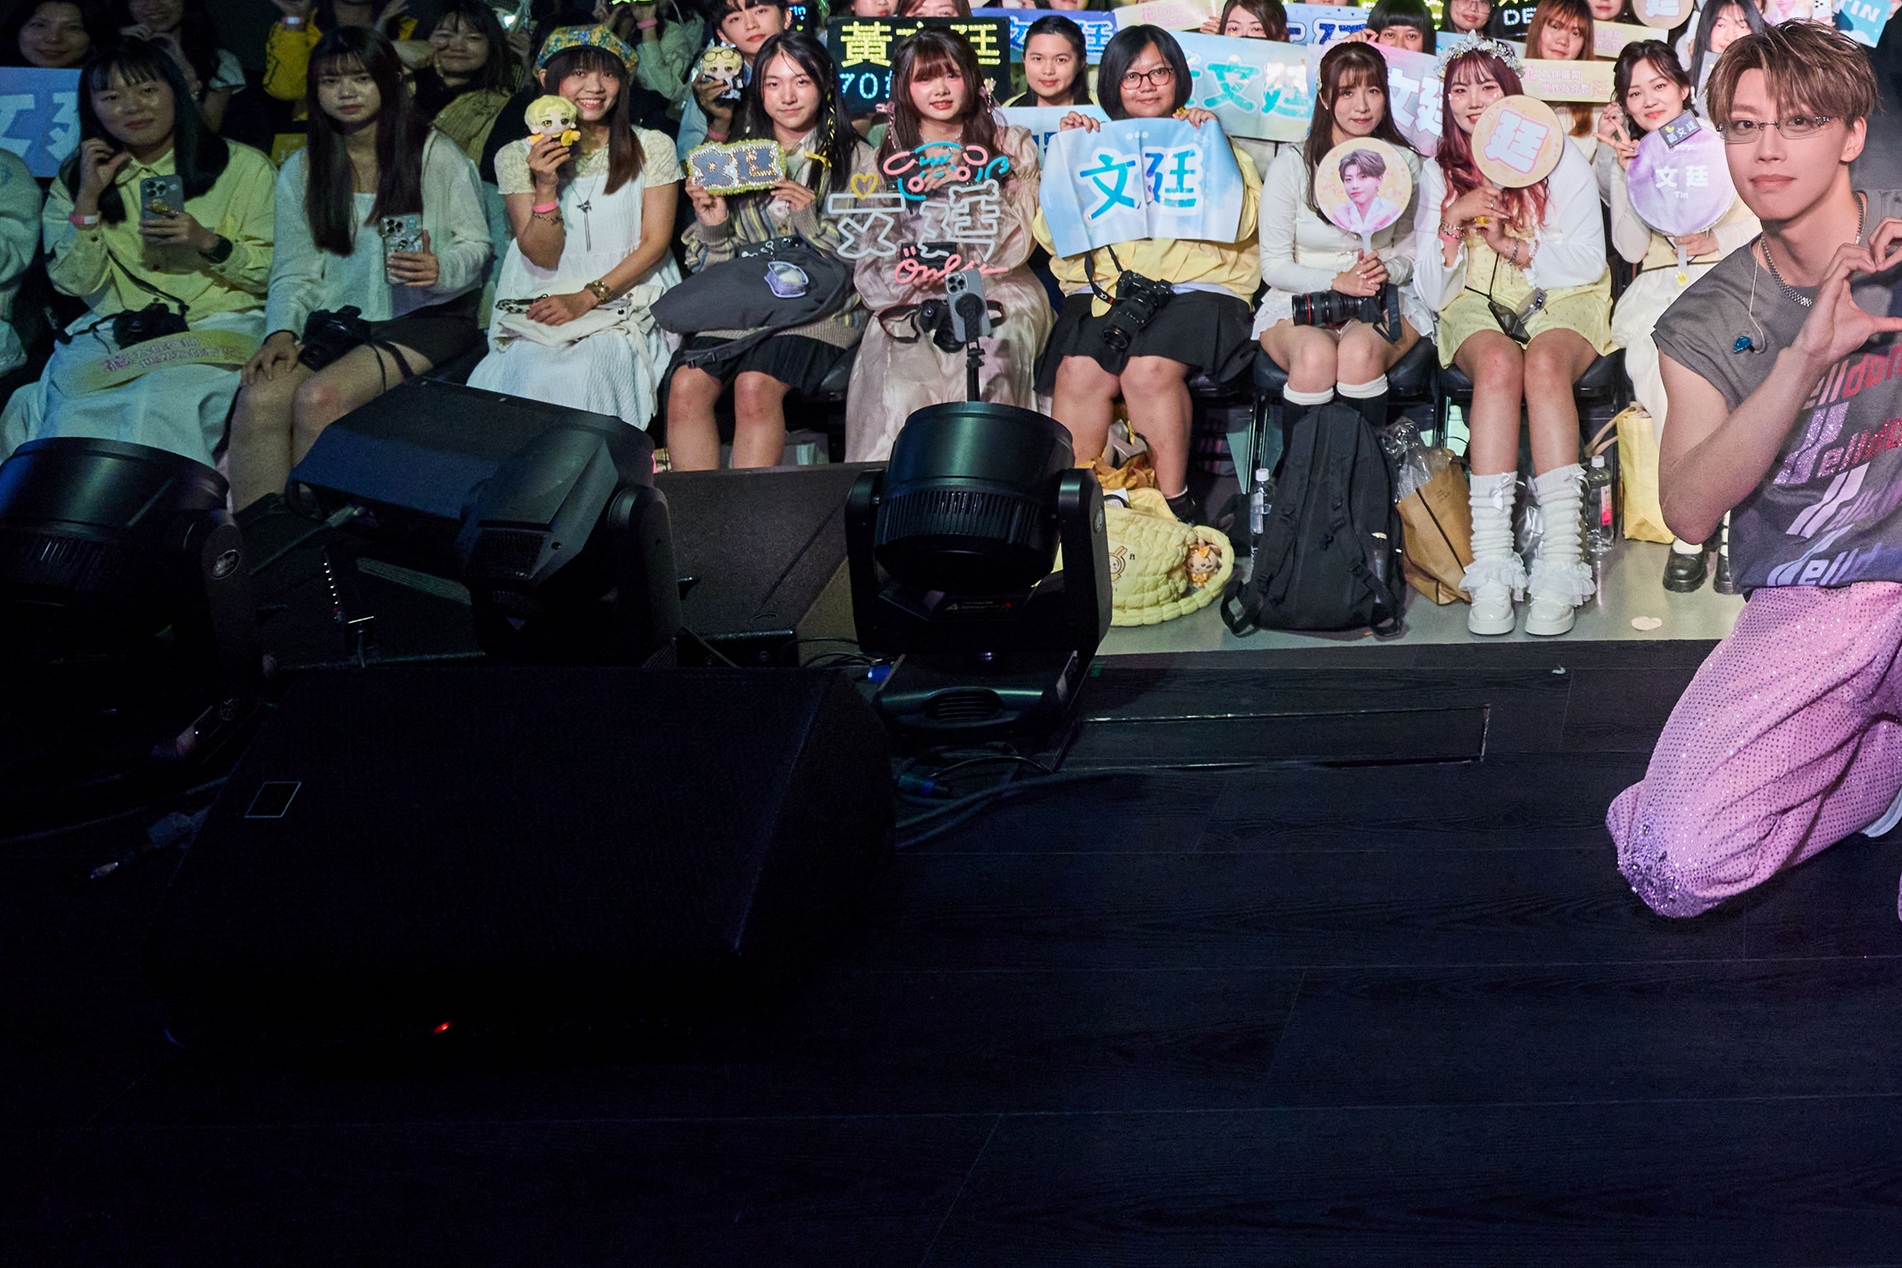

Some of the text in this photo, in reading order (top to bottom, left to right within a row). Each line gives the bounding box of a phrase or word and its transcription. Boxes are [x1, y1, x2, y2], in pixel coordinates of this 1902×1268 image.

[839, 69, 893, 99] 70
[1484, 109, 1550, 175] 廷
[1079, 148, 1198, 221] 文廷
[1655, 165, 1709, 188] 文廷
[1674, 191, 1688, 199] Tin
